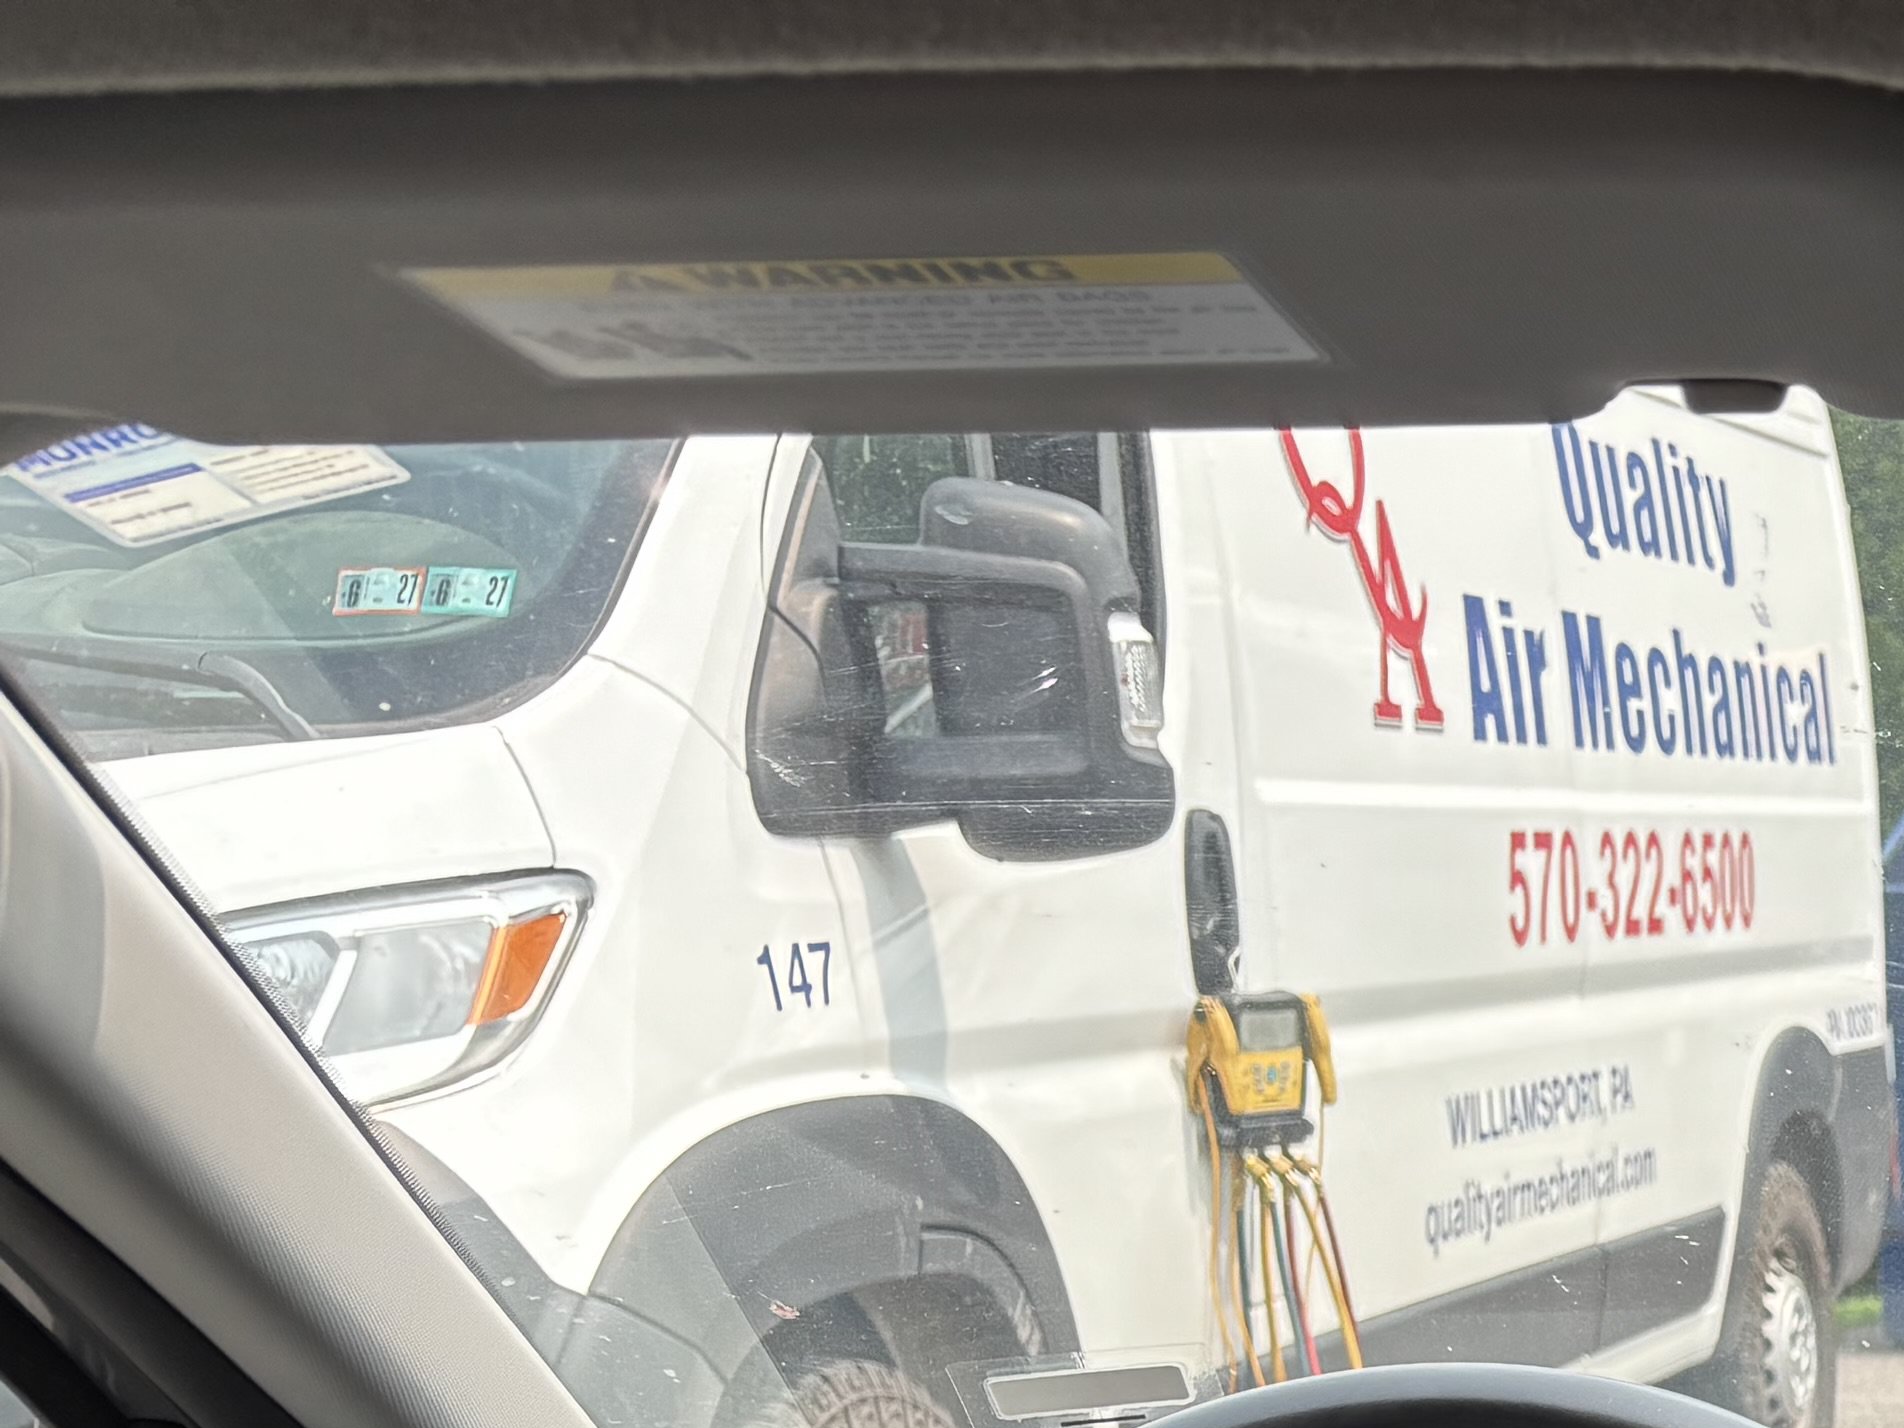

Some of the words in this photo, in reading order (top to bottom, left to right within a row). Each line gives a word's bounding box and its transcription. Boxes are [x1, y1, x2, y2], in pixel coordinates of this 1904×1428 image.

[690, 259, 1076, 289] WARNING
[1550, 418, 1737, 587] Quality
[396, 573, 420, 608] 27
[484, 575, 510, 608] 27
[1462, 593, 1548, 748] Air
[1561, 609, 1837, 766] Mechanical
[1508, 830, 1755, 948] 570-322-6500
[756, 941, 831, 1012] 147
[1445, 1067, 1608, 1150] WILLIAMSPORT,
[1610, 1062, 1636, 1114] PA
[1424, 1141, 1658, 1259] qualityairmechanical.com
